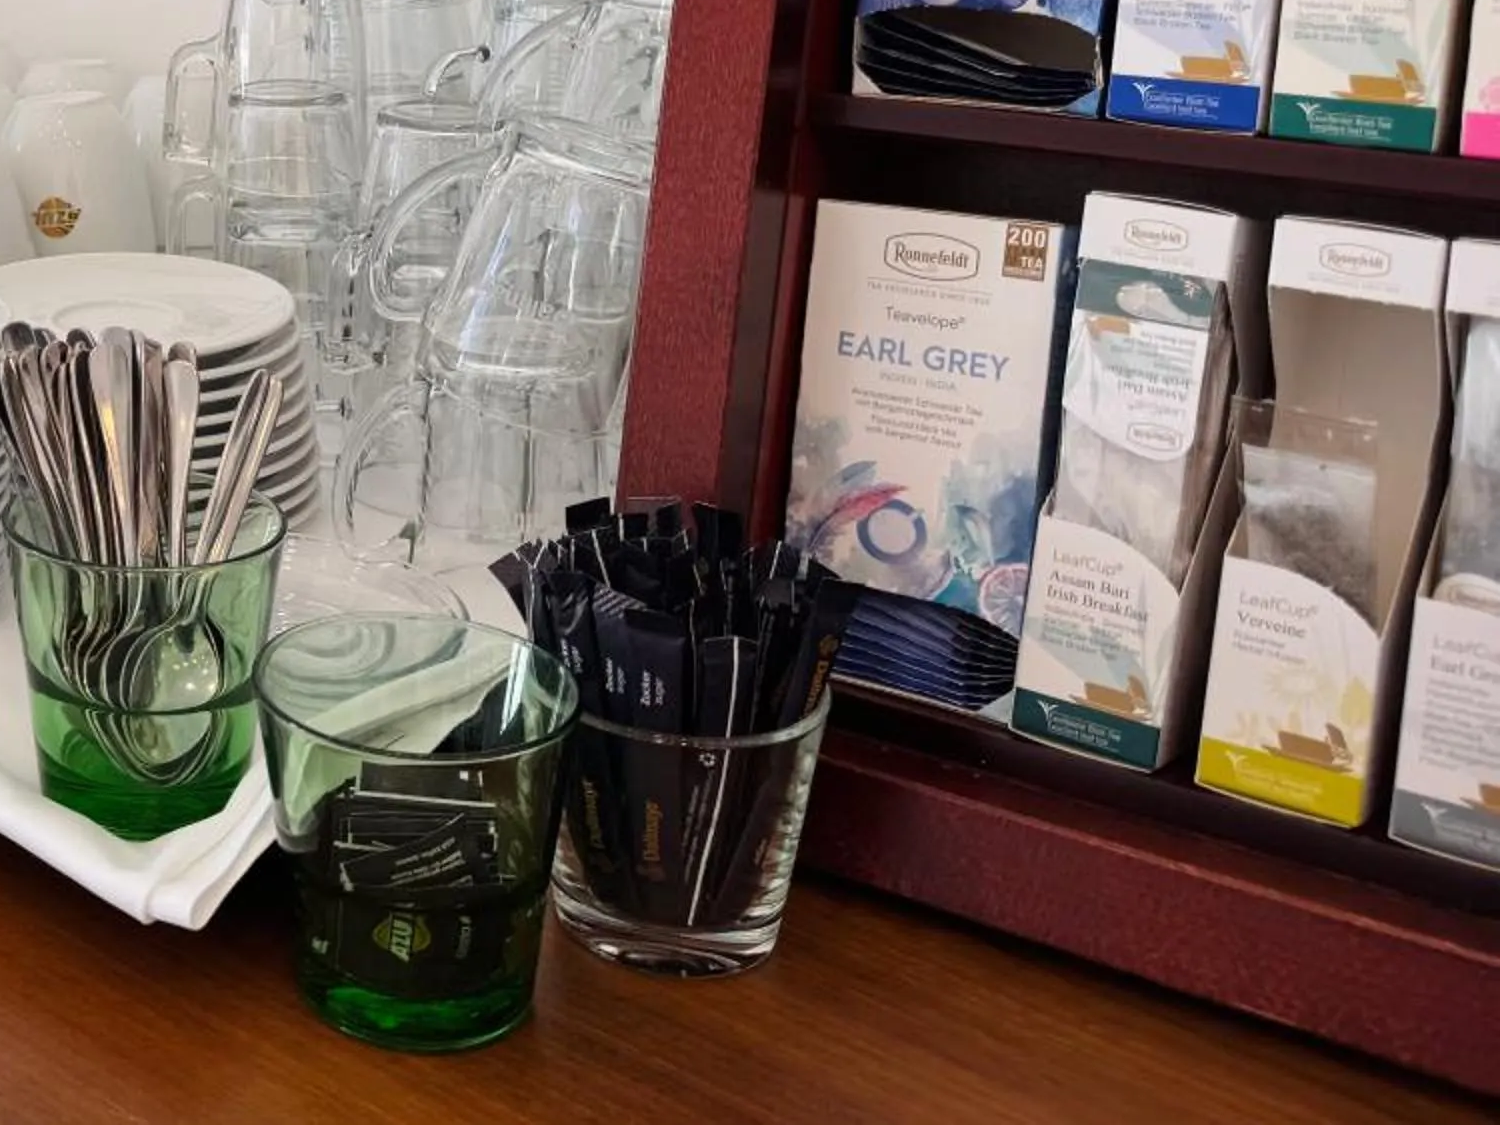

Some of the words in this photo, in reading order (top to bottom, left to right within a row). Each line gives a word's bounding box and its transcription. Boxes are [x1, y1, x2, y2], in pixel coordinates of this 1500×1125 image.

[1007, 226, 1047, 249] 200
[894, 241, 970, 269] Ronnefeldt
[1020, 256, 1043, 268] TEA
[838, 331, 912, 366] EARL
[923, 346, 1010, 381] GREY
[1050, 569, 1096, 591] Assam
[1046, 584, 1080, 606] Irish
[1082, 591, 1150, 623] Breakfast
[1237, 610, 1307, 639] Verveine
[639, 669, 652, 707] Zucker
[642, 799, 664, 862] Dallmayr
